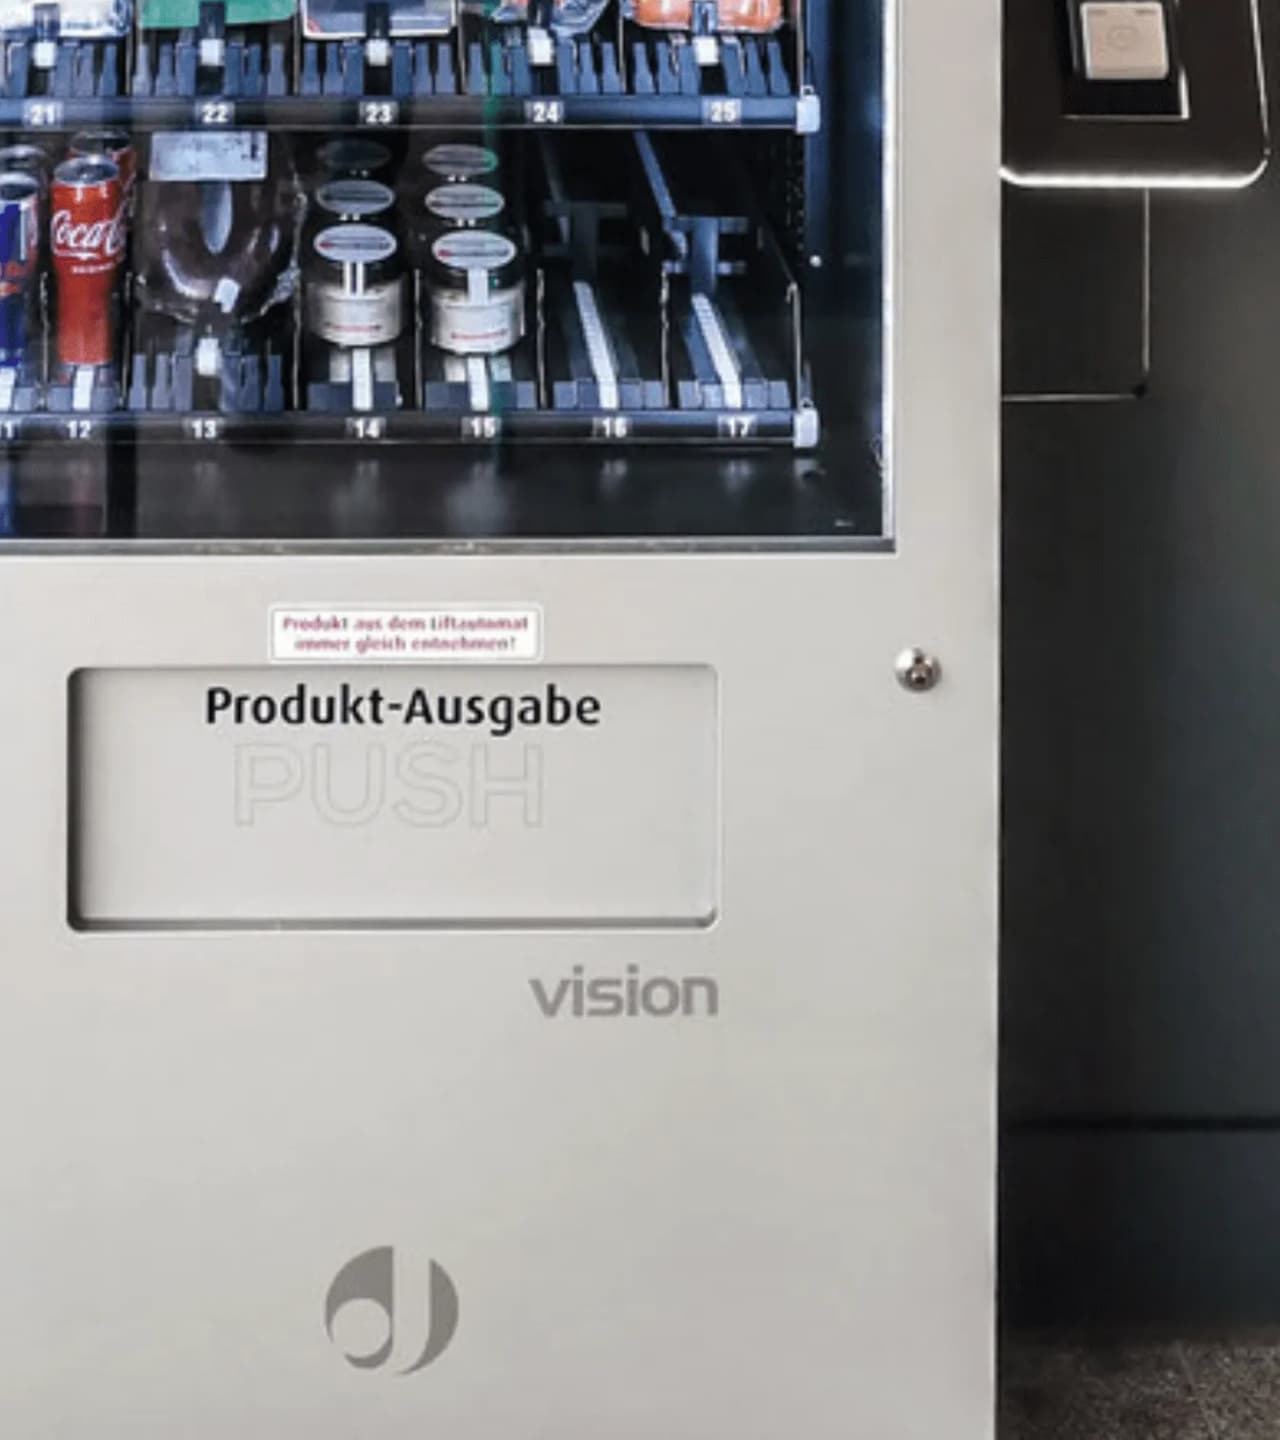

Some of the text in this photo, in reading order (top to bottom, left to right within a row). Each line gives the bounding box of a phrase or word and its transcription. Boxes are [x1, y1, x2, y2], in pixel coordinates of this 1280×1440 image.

[31, 103, 56, 125] 21
[202, 102, 229, 123] 22
[365, 101, 392, 123] 23
[533, 101, 558, 123] 24
[711, 101, 736, 122] 25
[67, 420, 91, 439] 12
[192, 420, 217, 439] 13
[355, 418, 380, 439] 14
[471, 418, 495, 439] 15
[605, 418, 627, 439] 16
[728, 418, 749, 438] 17
[282, 615, 529, 631] Produkt aus dem Liftautomat
[294, 635, 516, 654] immer gleich entnehmen!
[206, 682, 601, 737] Produkt-Ausgabe
[233, 741, 544, 828] PUSH
[528, 964, 719, 1018] vision
